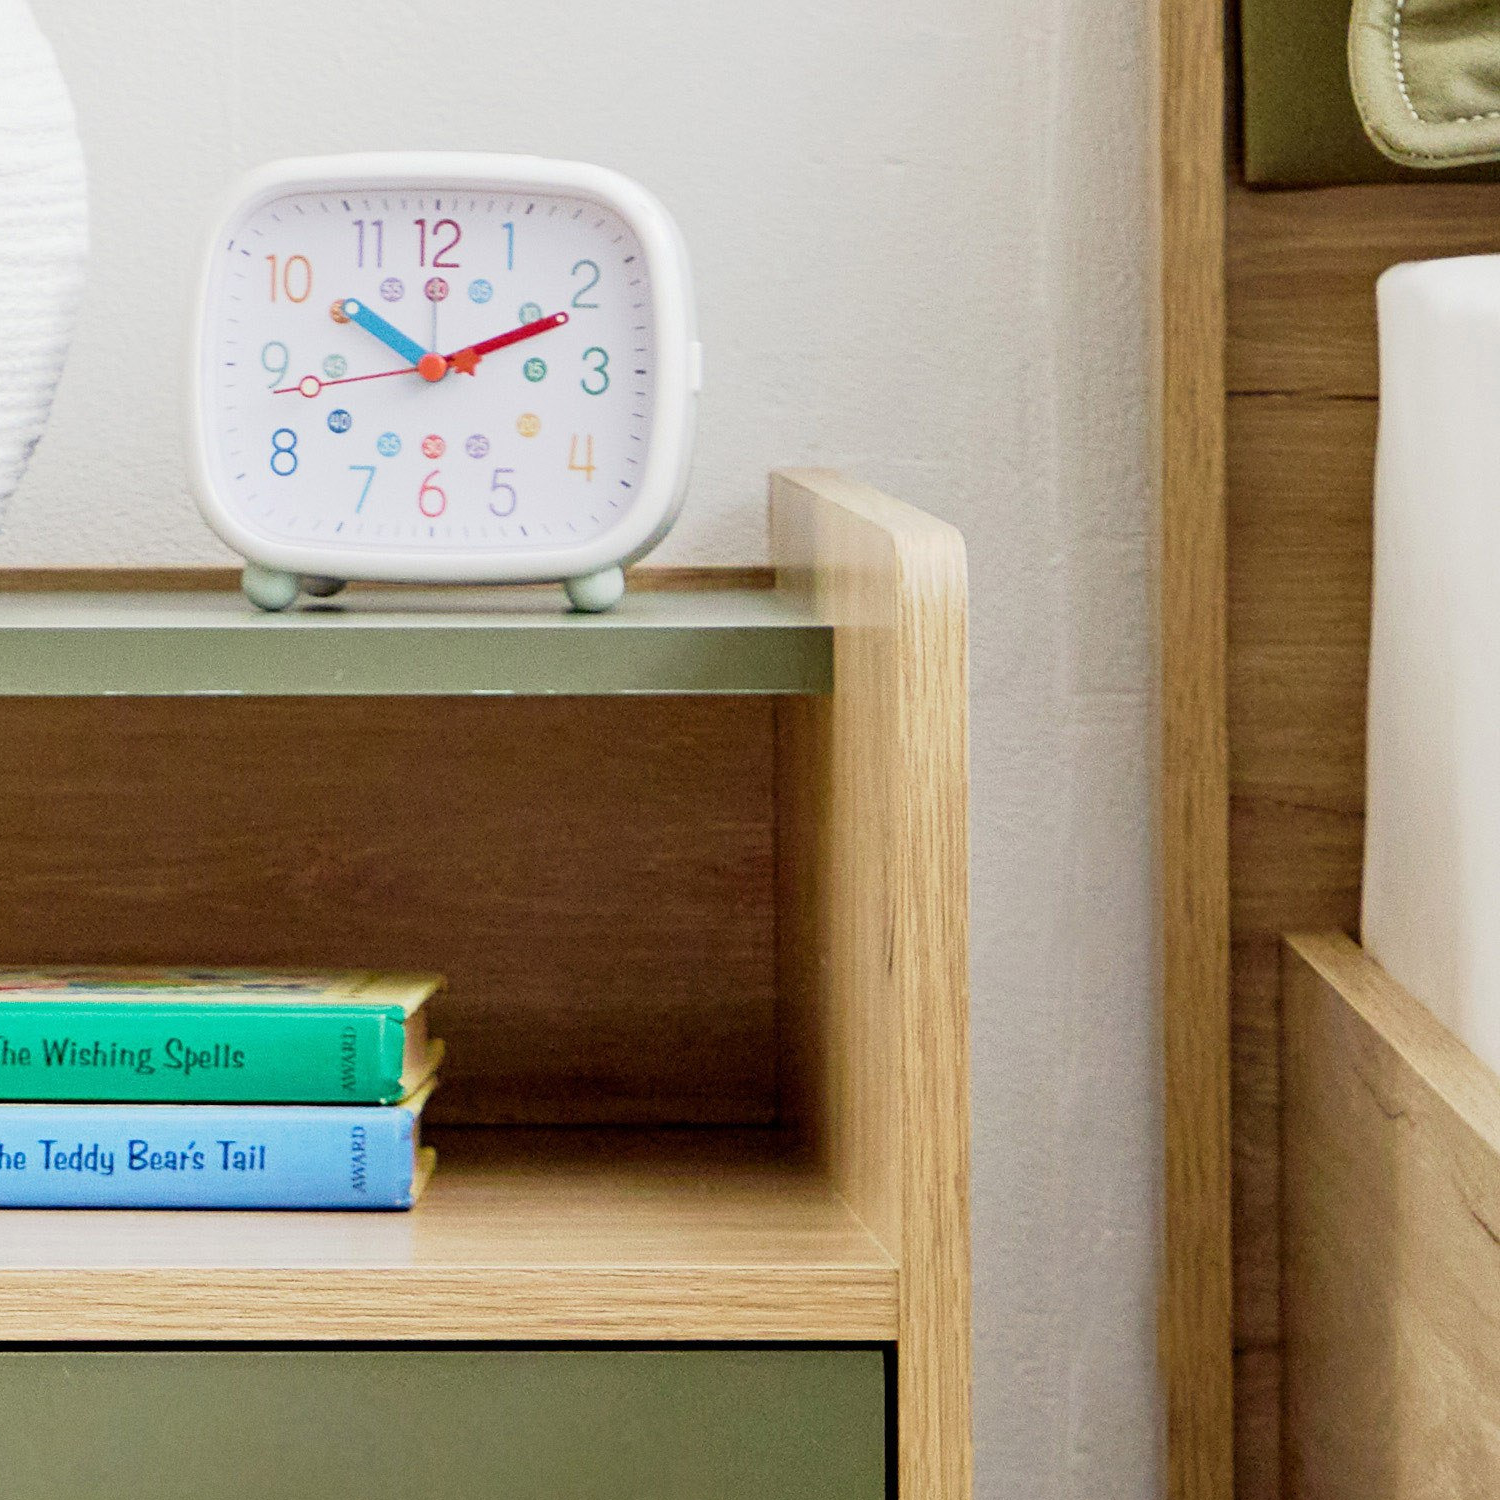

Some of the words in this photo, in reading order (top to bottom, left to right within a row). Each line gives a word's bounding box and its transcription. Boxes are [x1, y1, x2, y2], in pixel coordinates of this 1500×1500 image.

[352, 219, 383, 269] 11
[413, 218, 462, 268] 12
[502, 221, 514, 270] 1
[266, 254, 312, 304] 10
[571, 259, 601, 309] 2
[261, 341, 289, 389] 9
[581, 346, 610, 396] 3
[270, 428, 298, 476] 8
[567, 434, 596, 482] 4
[348, 465, 377, 514] 7
[418, 469, 448, 518] 6
[488, 468, 517, 517] 5
[42, 1038, 155, 1074] Wishing
[164, 1038, 245, 1075] Spells
[340, 1026, 358, 1092] AWARD
[38, 1139, 114, 1175] Teddy
[127, 1139, 205, 1171] Bear's
[216, 1140, 266, 1170] Tail
[352, 1126, 366, 1193] AWARD
